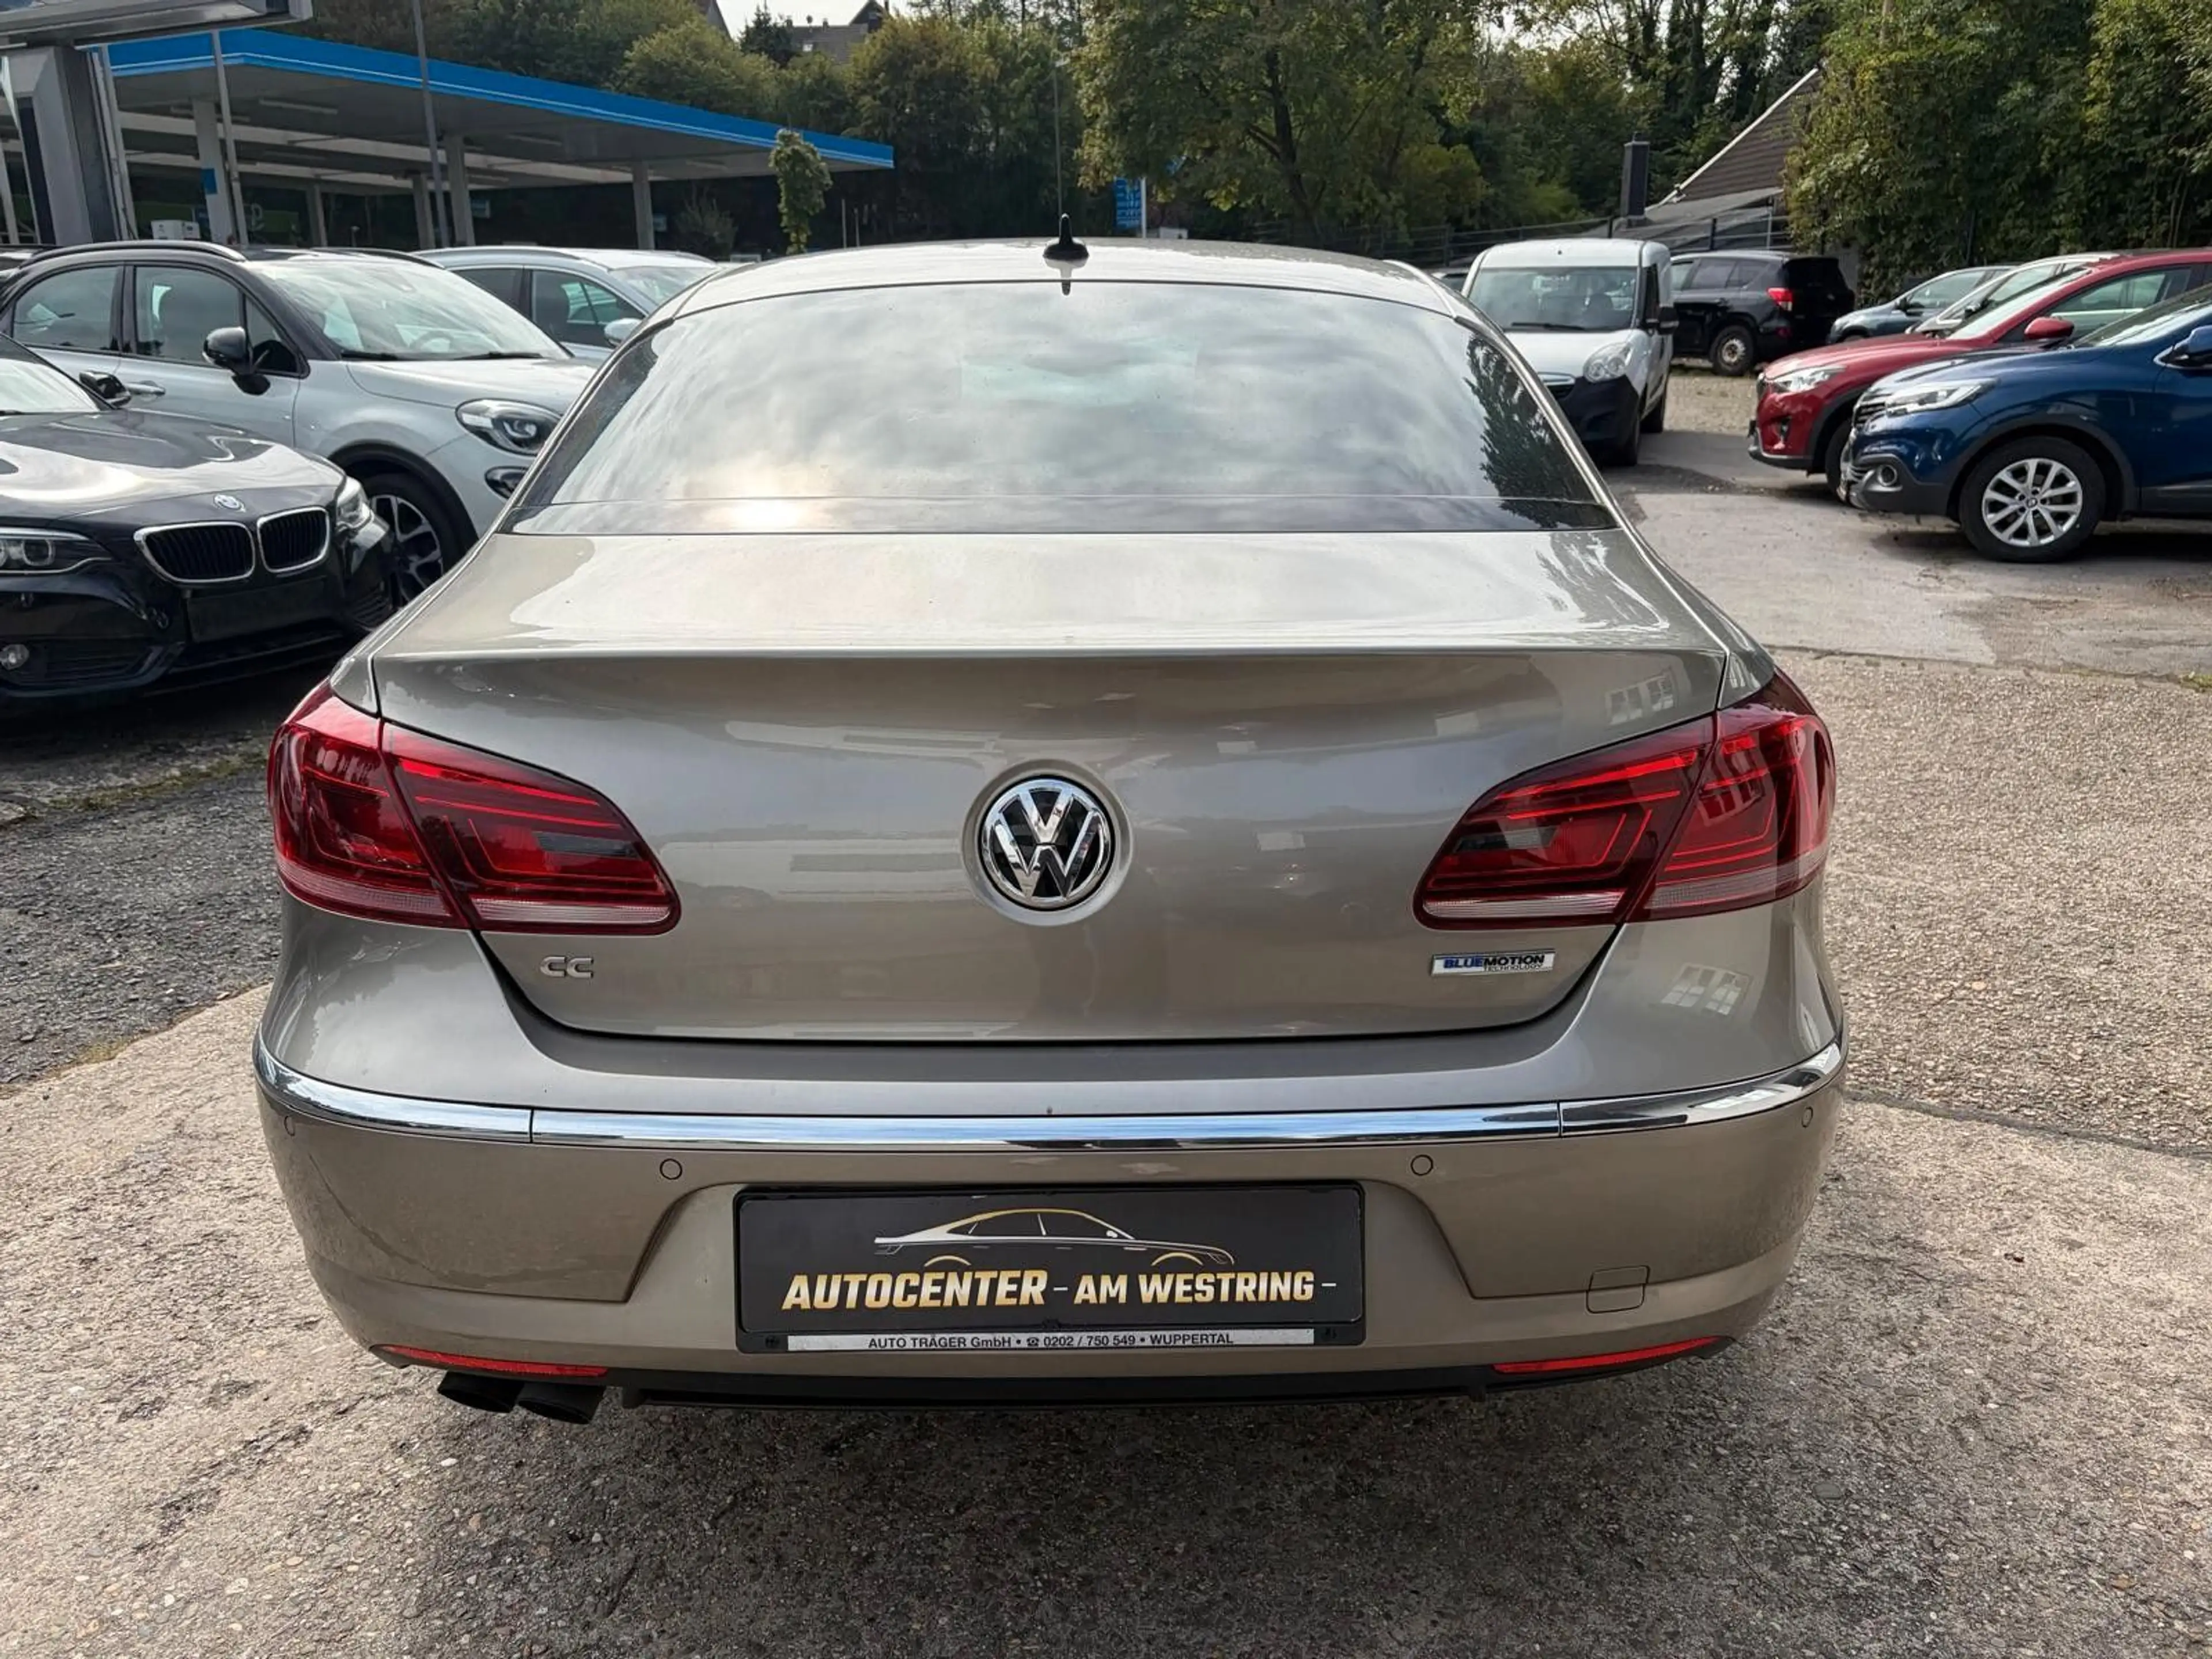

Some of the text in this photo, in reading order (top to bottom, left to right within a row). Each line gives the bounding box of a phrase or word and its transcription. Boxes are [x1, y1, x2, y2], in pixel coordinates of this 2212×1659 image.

[982, 777, 1112, 907] VW
[540, 956, 594, 978] CC
[1444, 955, 1545, 968] BLUEMOTION
[781, 1269, 1048, 1310] AUTOCENTER
[1073, 1274, 1128, 1304] AM
[1138, 1271, 1315, 1304] WESTRING
[868, 1338, 907, 1349] AUTO
[912, 1335, 967, 1348] TRÄGER
[971, 1337, 1012, 1348] GmbH
[1043, 1336, 1074, 1347] 0202
[1086, 1335, 1110, 1346] 750
[1112, 1335, 1136, 1346] 549
[1150, 1333, 1234, 1345] WUPPERTAL
